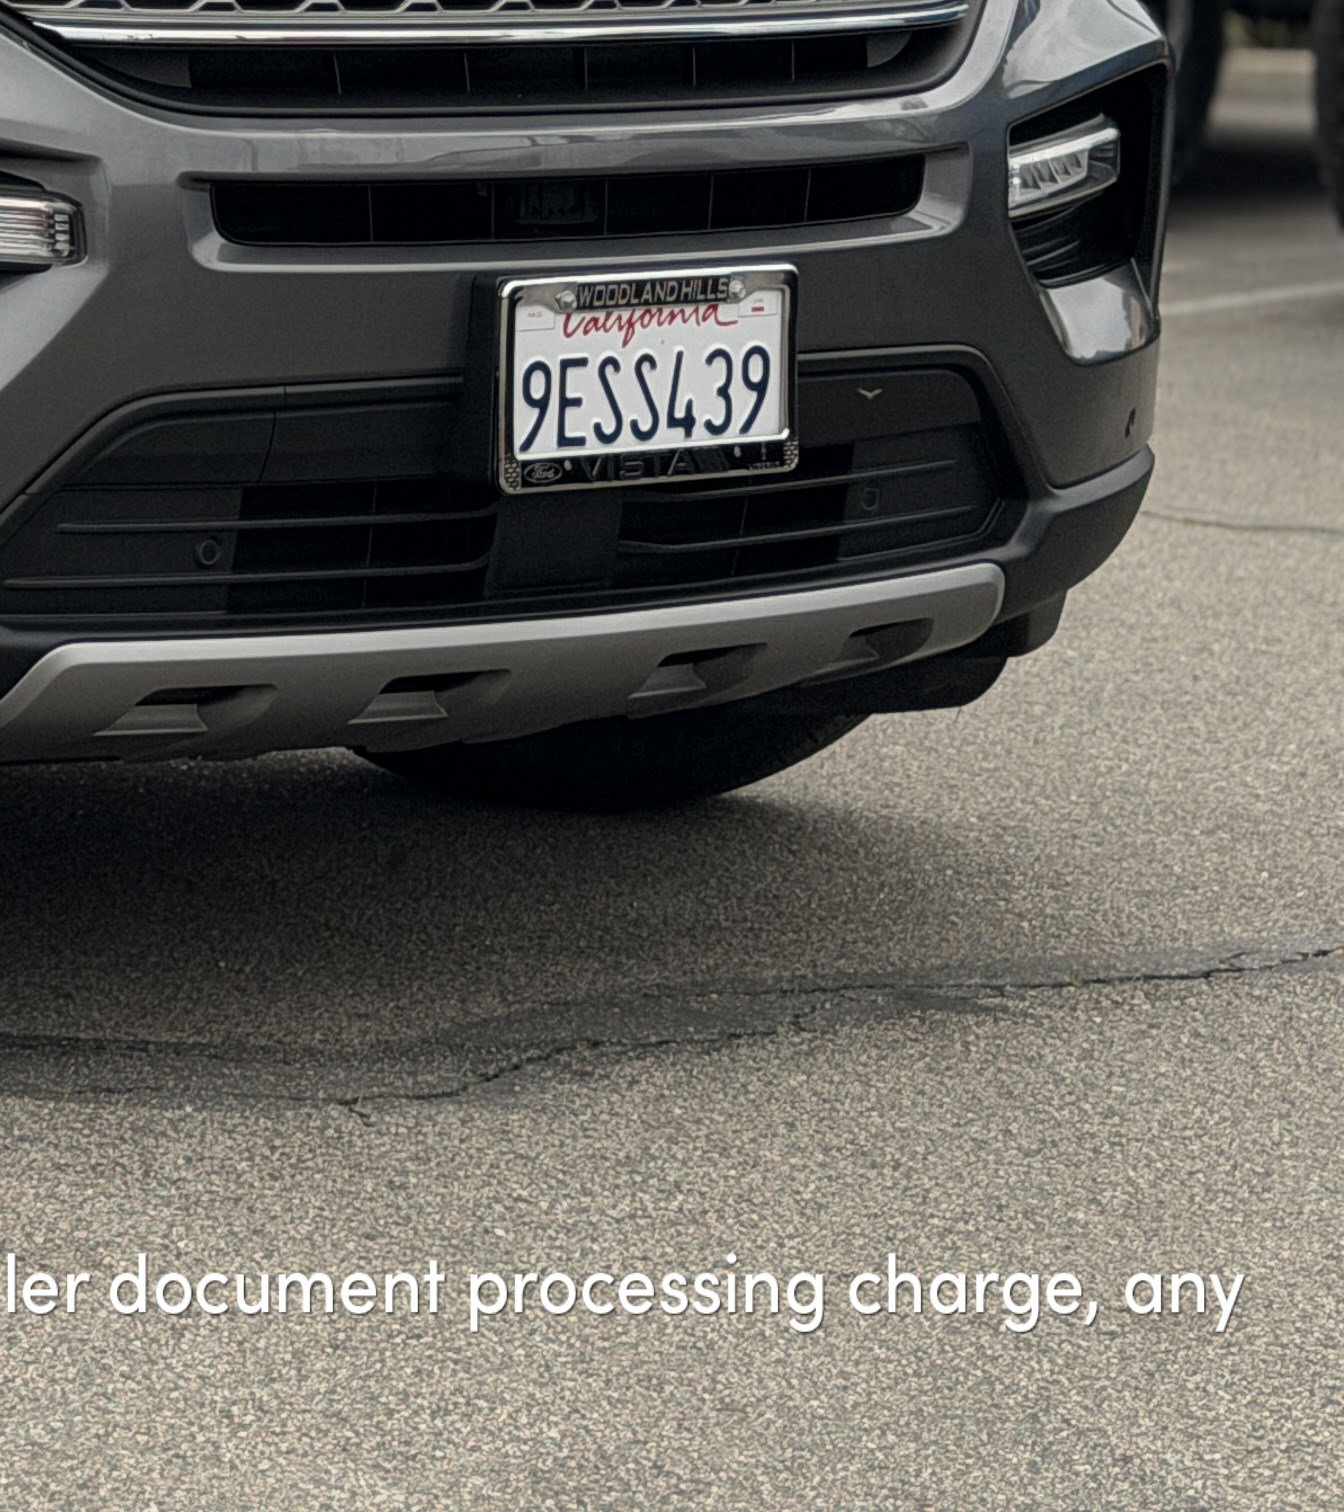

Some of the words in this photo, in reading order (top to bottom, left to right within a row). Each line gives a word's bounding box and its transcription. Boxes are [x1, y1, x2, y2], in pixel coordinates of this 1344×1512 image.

[577, 279, 678, 309] WOODLAND
[683, 277, 729, 301] HILLS
[562, 303, 740, 349] California
[518, 344, 773, 454] 9ESS439
